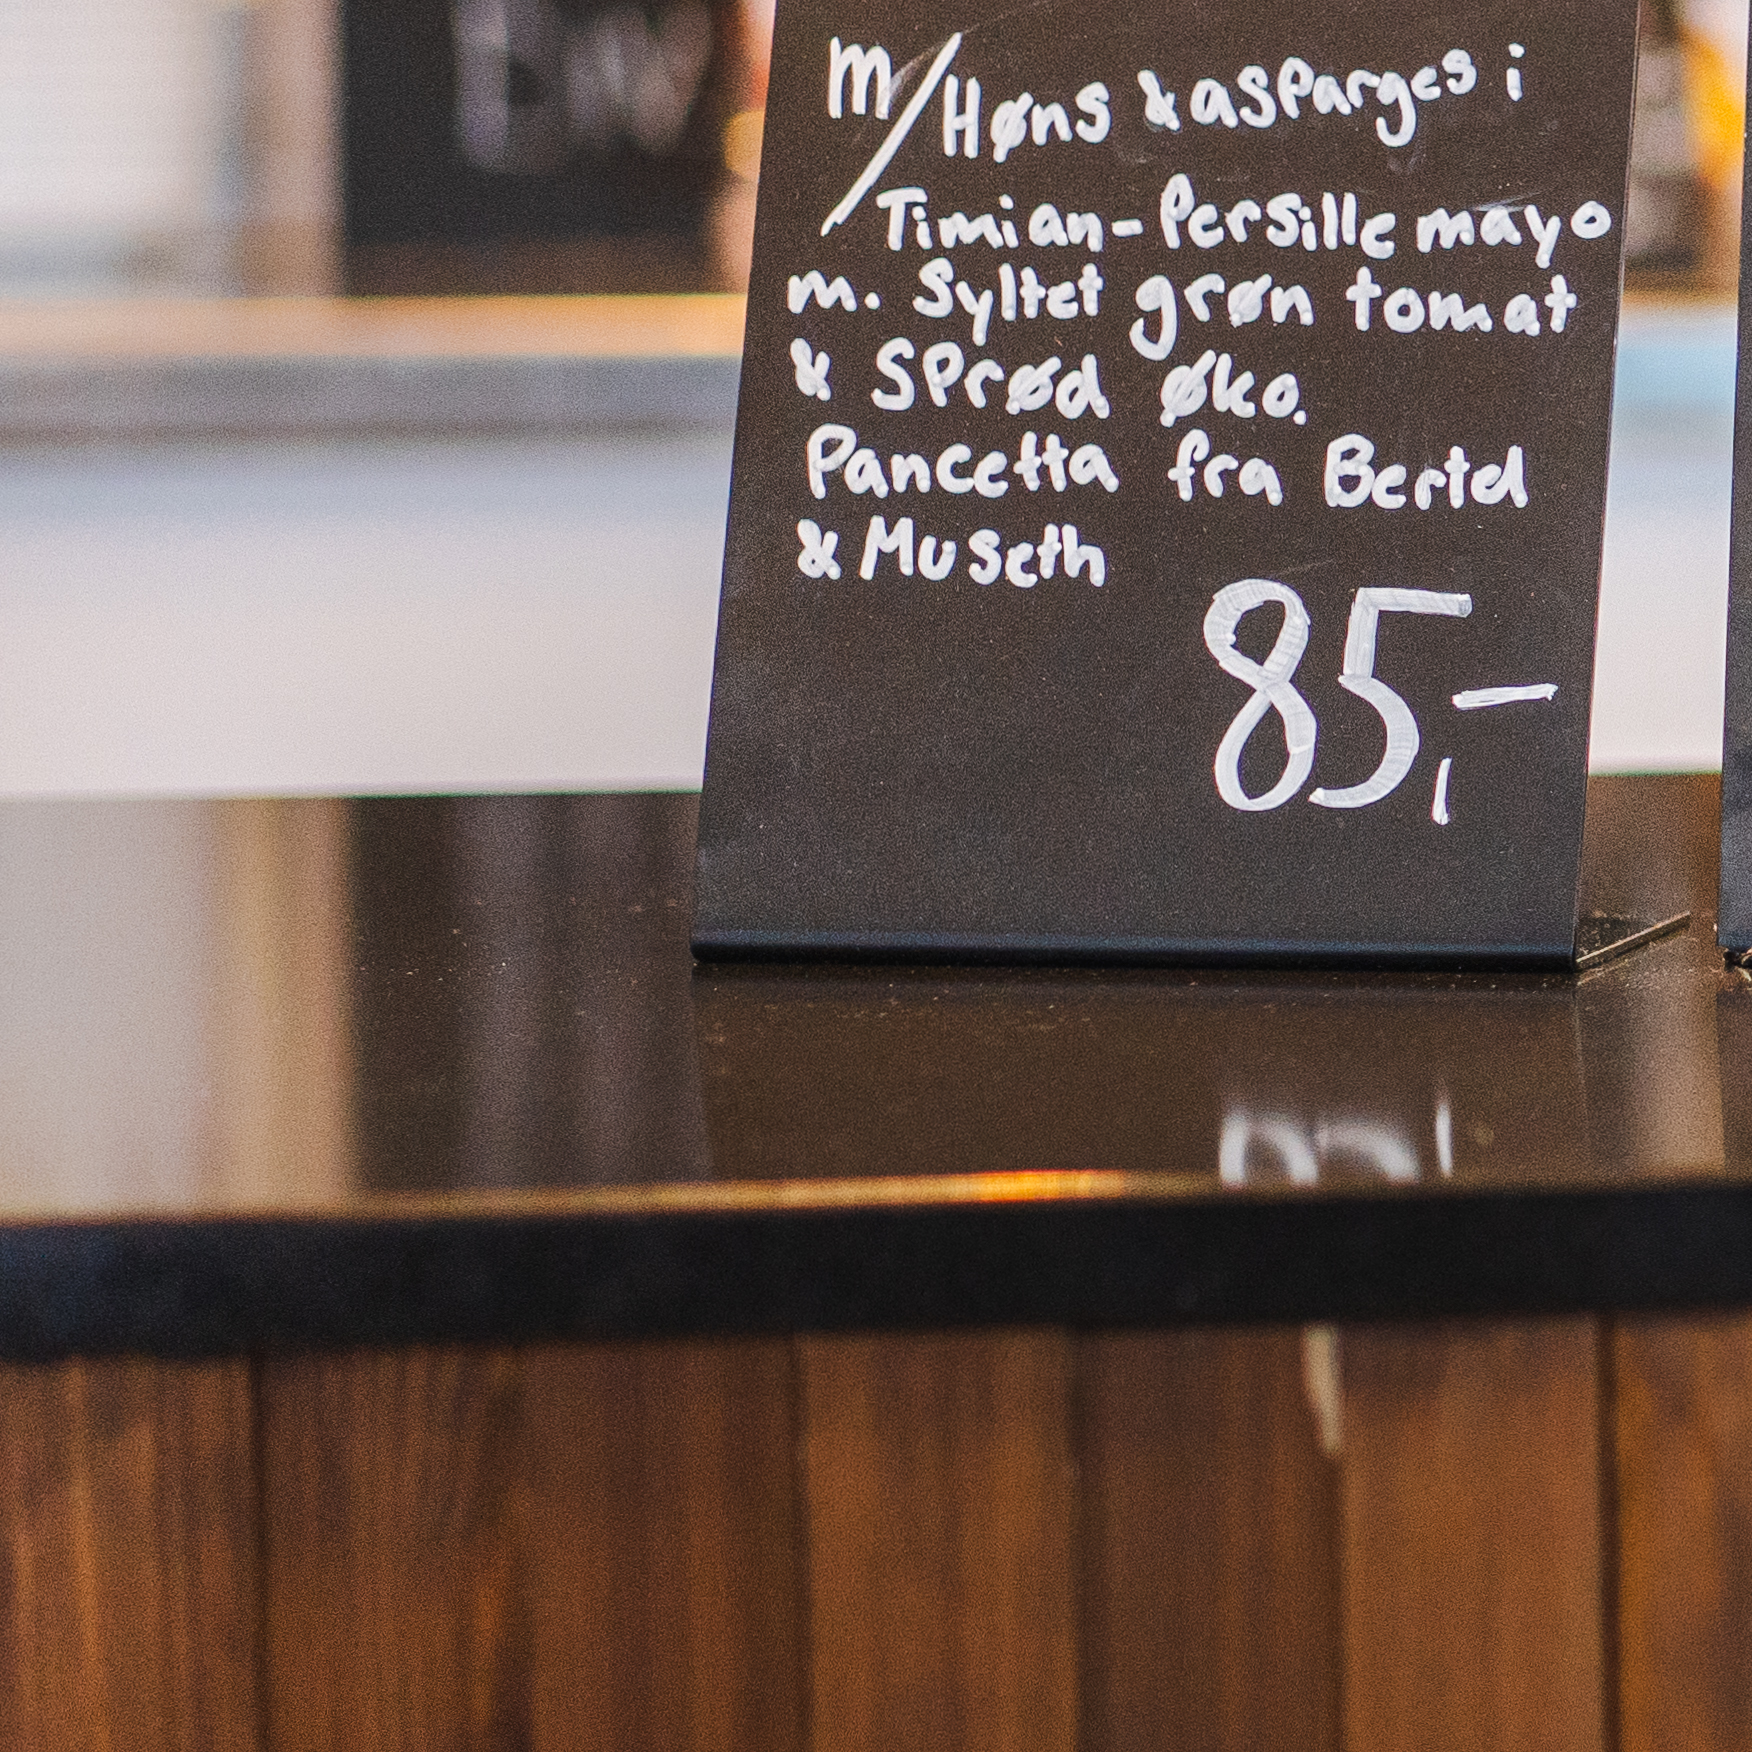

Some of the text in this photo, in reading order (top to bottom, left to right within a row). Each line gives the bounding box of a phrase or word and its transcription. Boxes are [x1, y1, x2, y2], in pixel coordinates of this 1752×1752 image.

[1505, 42, 1526, 102] i
[1415, 199, 1613, 270] mayo
[786, 269, 881, 315] m.
[911, 256, 1104, 352] Syltet
[1128, 273, 1315, 362] grøn
[805, 422, 1120, 500] Pancetta
[1166, 428, 1284, 507] fra
[795, 518, 842, 581] &
[1202, 577, 1559, 826] 85,-
